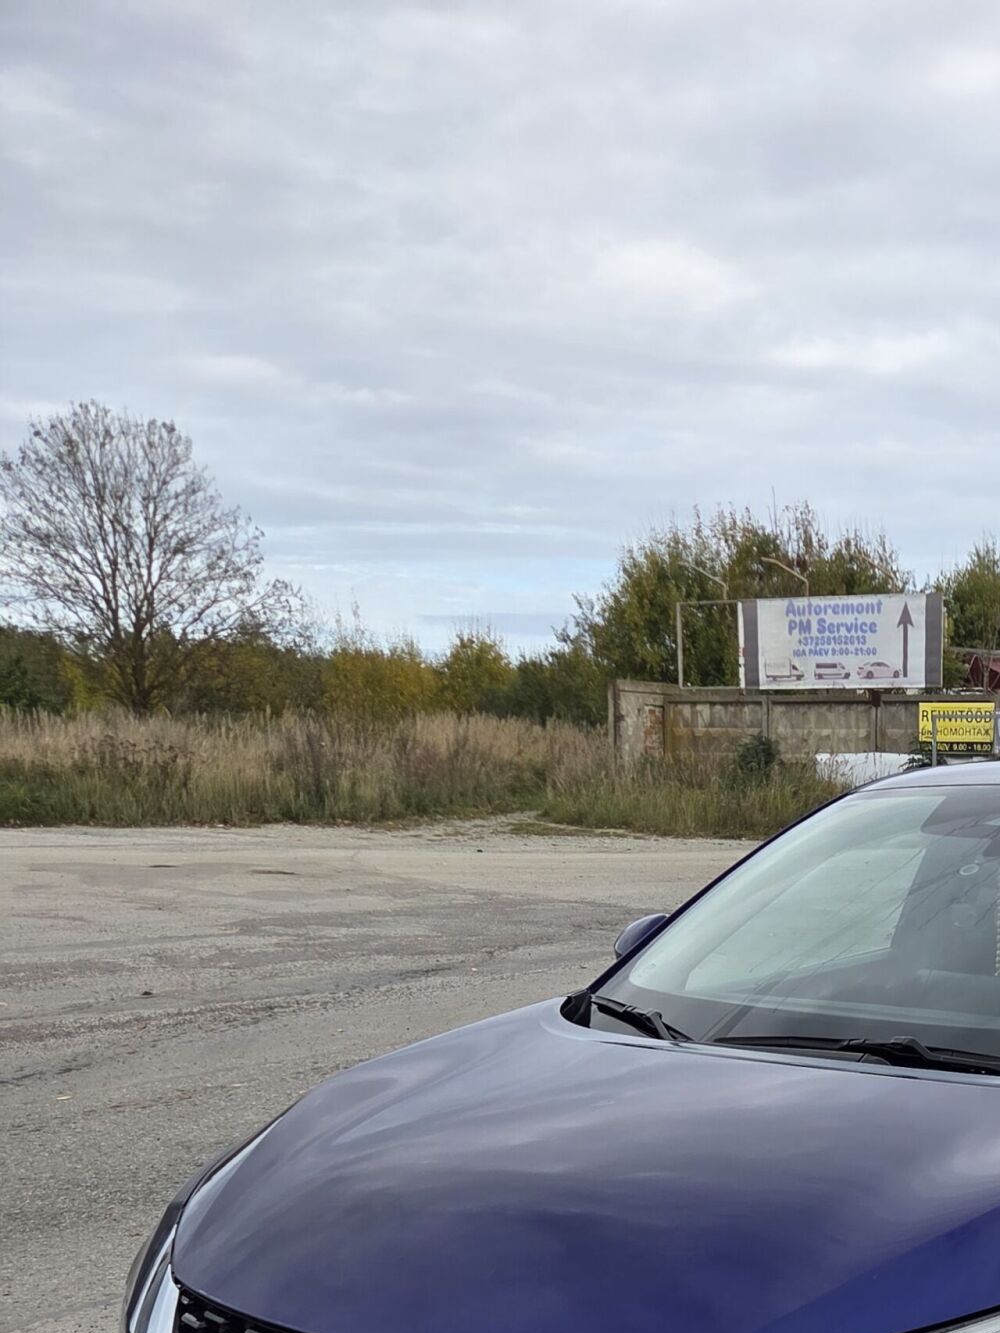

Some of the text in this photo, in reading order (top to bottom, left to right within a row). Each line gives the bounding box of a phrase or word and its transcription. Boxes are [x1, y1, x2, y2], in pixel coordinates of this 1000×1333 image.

[785, 600, 883, 617] Autoremont
[788, 618, 877, 636] PM Service
